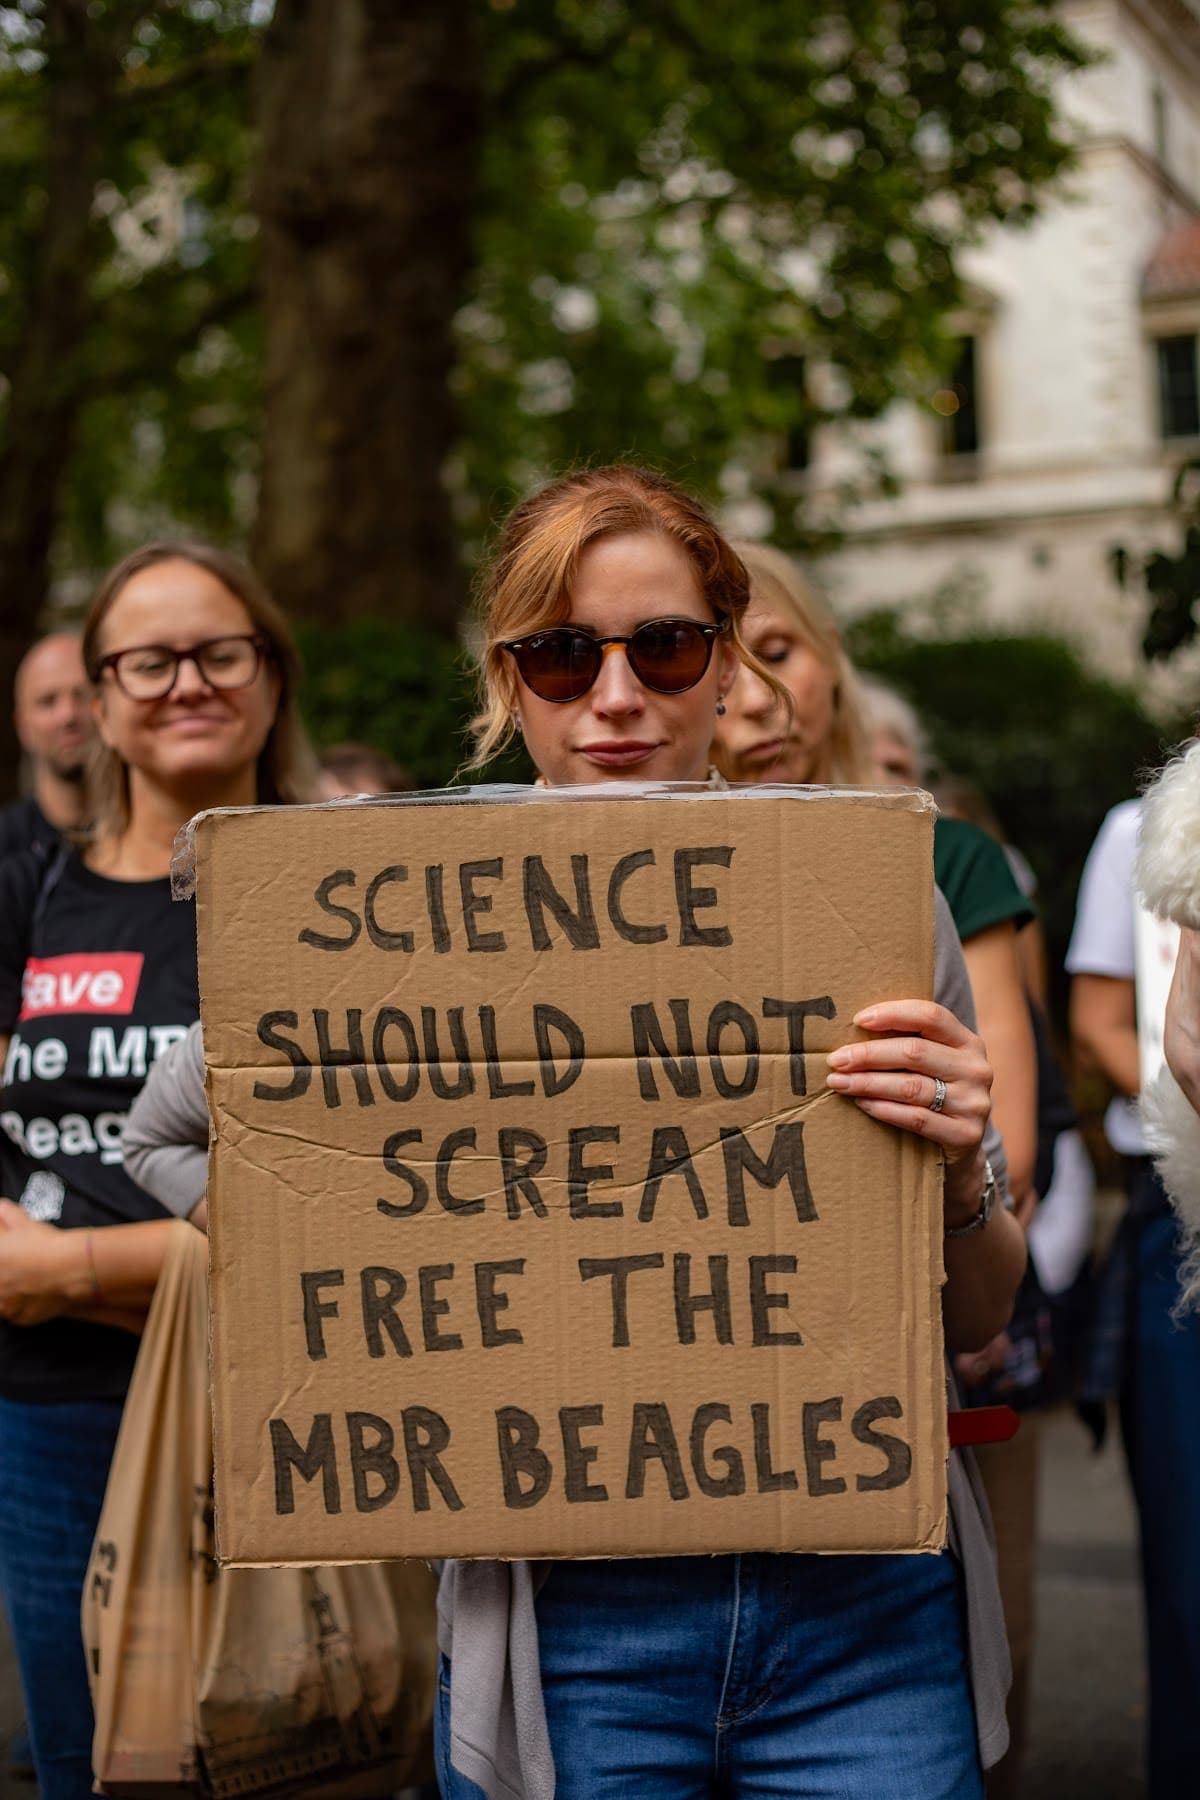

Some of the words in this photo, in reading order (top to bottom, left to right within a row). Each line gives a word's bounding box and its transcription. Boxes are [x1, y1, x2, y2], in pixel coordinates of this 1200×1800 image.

[298, 845, 737, 955] SCIENCE
[3, 1033, 68, 1088] he
[252, 1003, 586, 1110] SHOULD
[630, 995, 836, 1101] NOT
[0, 1110, 125, 1165] eag
[376, 1121, 819, 1228] SCREAM
[300, 1257, 527, 1362] FREE
[577, 1251, 804, 1348] THE
[268, 1405, 466, 1516] MBR
[494, 1395, 913, 1510] BEAGLES
